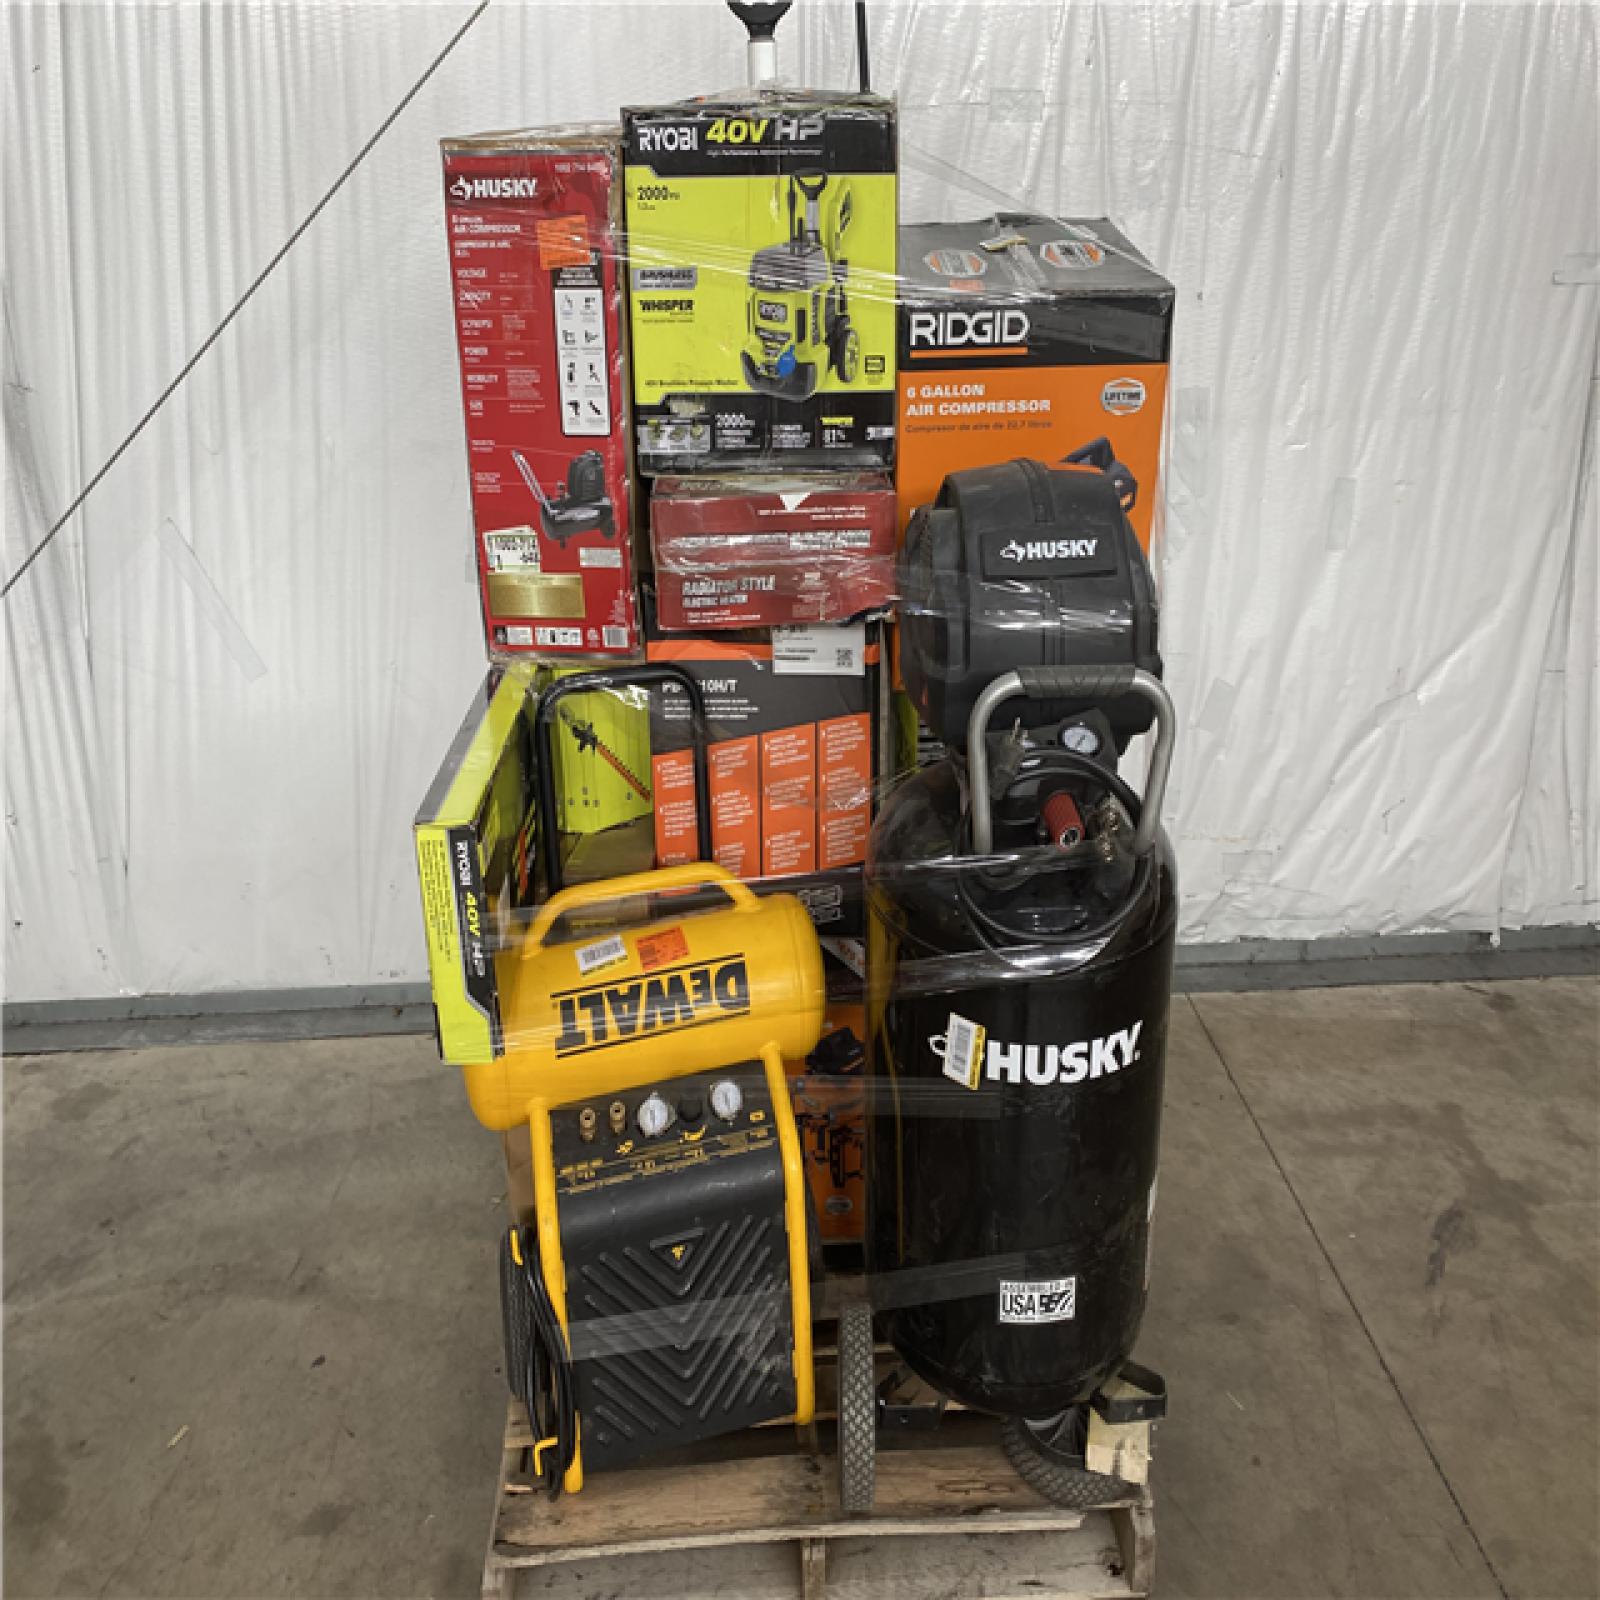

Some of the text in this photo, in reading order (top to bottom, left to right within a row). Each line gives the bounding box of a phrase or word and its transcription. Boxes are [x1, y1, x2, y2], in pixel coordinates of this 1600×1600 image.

[637, 119, 825, 151] RYOBI 40V HP
[473, 177, 538, 199] HUSKY
[637, 186, 668, 200] 2000
[638, 300, 693, 311] WHISPER
[910, 310, 1030, 346] RIDGID
[920, 384, 986, 398] GALLON
[906, 400, 1051, 416] AIR COMPRESSOR
[714, 412, 746, 428] 2000
[1026, 539, 1098, 561] HUSKY
[740, 574, 776, 592] STYLE
[454, 839, 472, 886] RYOBI
[465, 890, 482, 937] 40V
[986, 1019, 1144, 1086] HUSKY
[1001, 1293, 1036, 1316] USA
